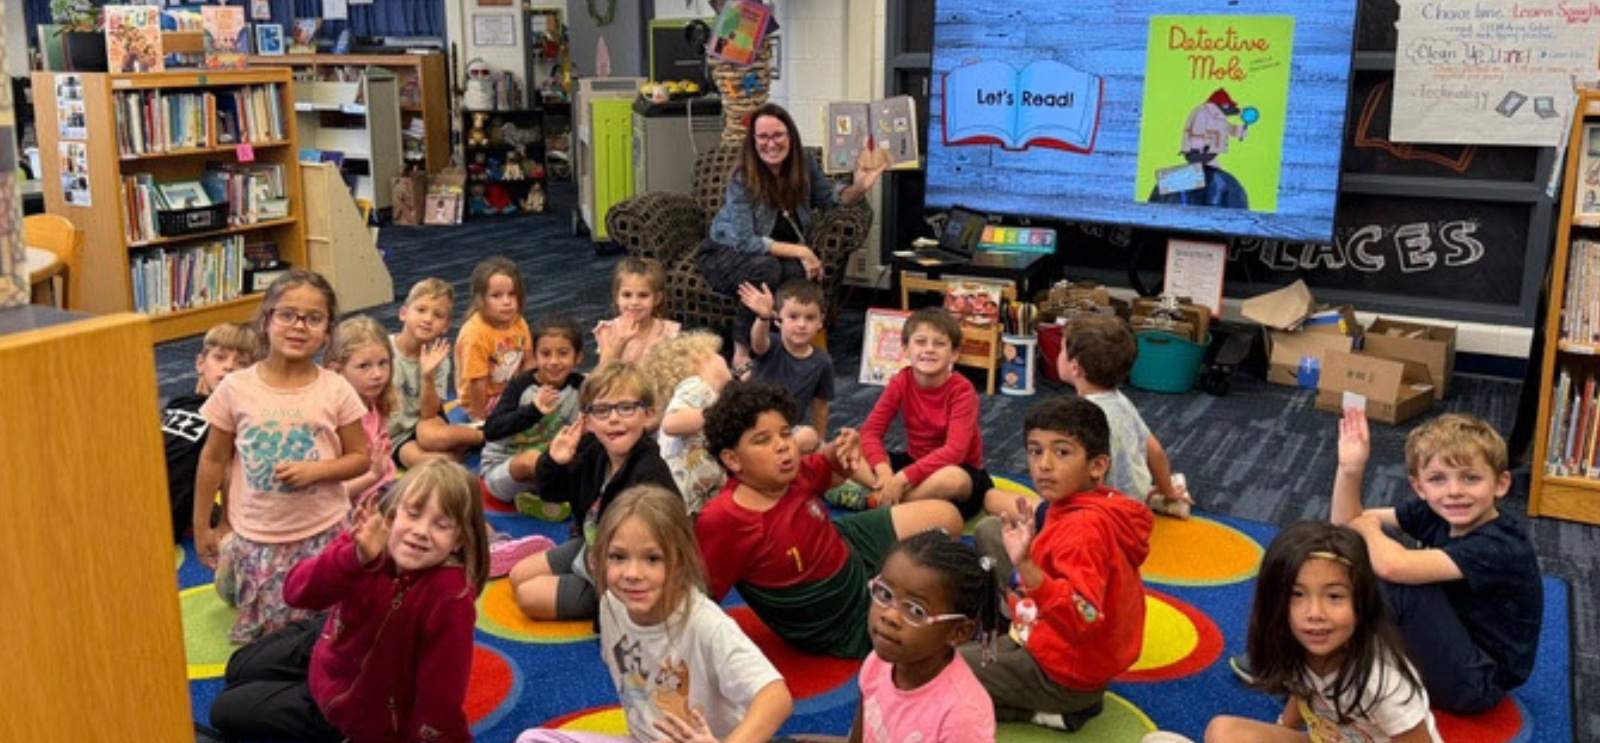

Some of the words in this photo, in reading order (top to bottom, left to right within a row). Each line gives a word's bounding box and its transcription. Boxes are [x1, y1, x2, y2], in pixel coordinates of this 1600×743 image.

[1511, 4, 1554, 19] Learn
[1168, 24, 1270, 53] Detective
[1416, 43, 1457, 60] Clean
[1464, 42, 1486, 66] Up
[1187, 54, 1248, 82] Mole
[976, 87, 1015, 107] Let's
[1021, 89, 1076, 109] Read!
[1419, 83, 1490, 110] Technology
[1227, 220, 1485, 273] PLACES
[786, 546, 805, 572] 7
